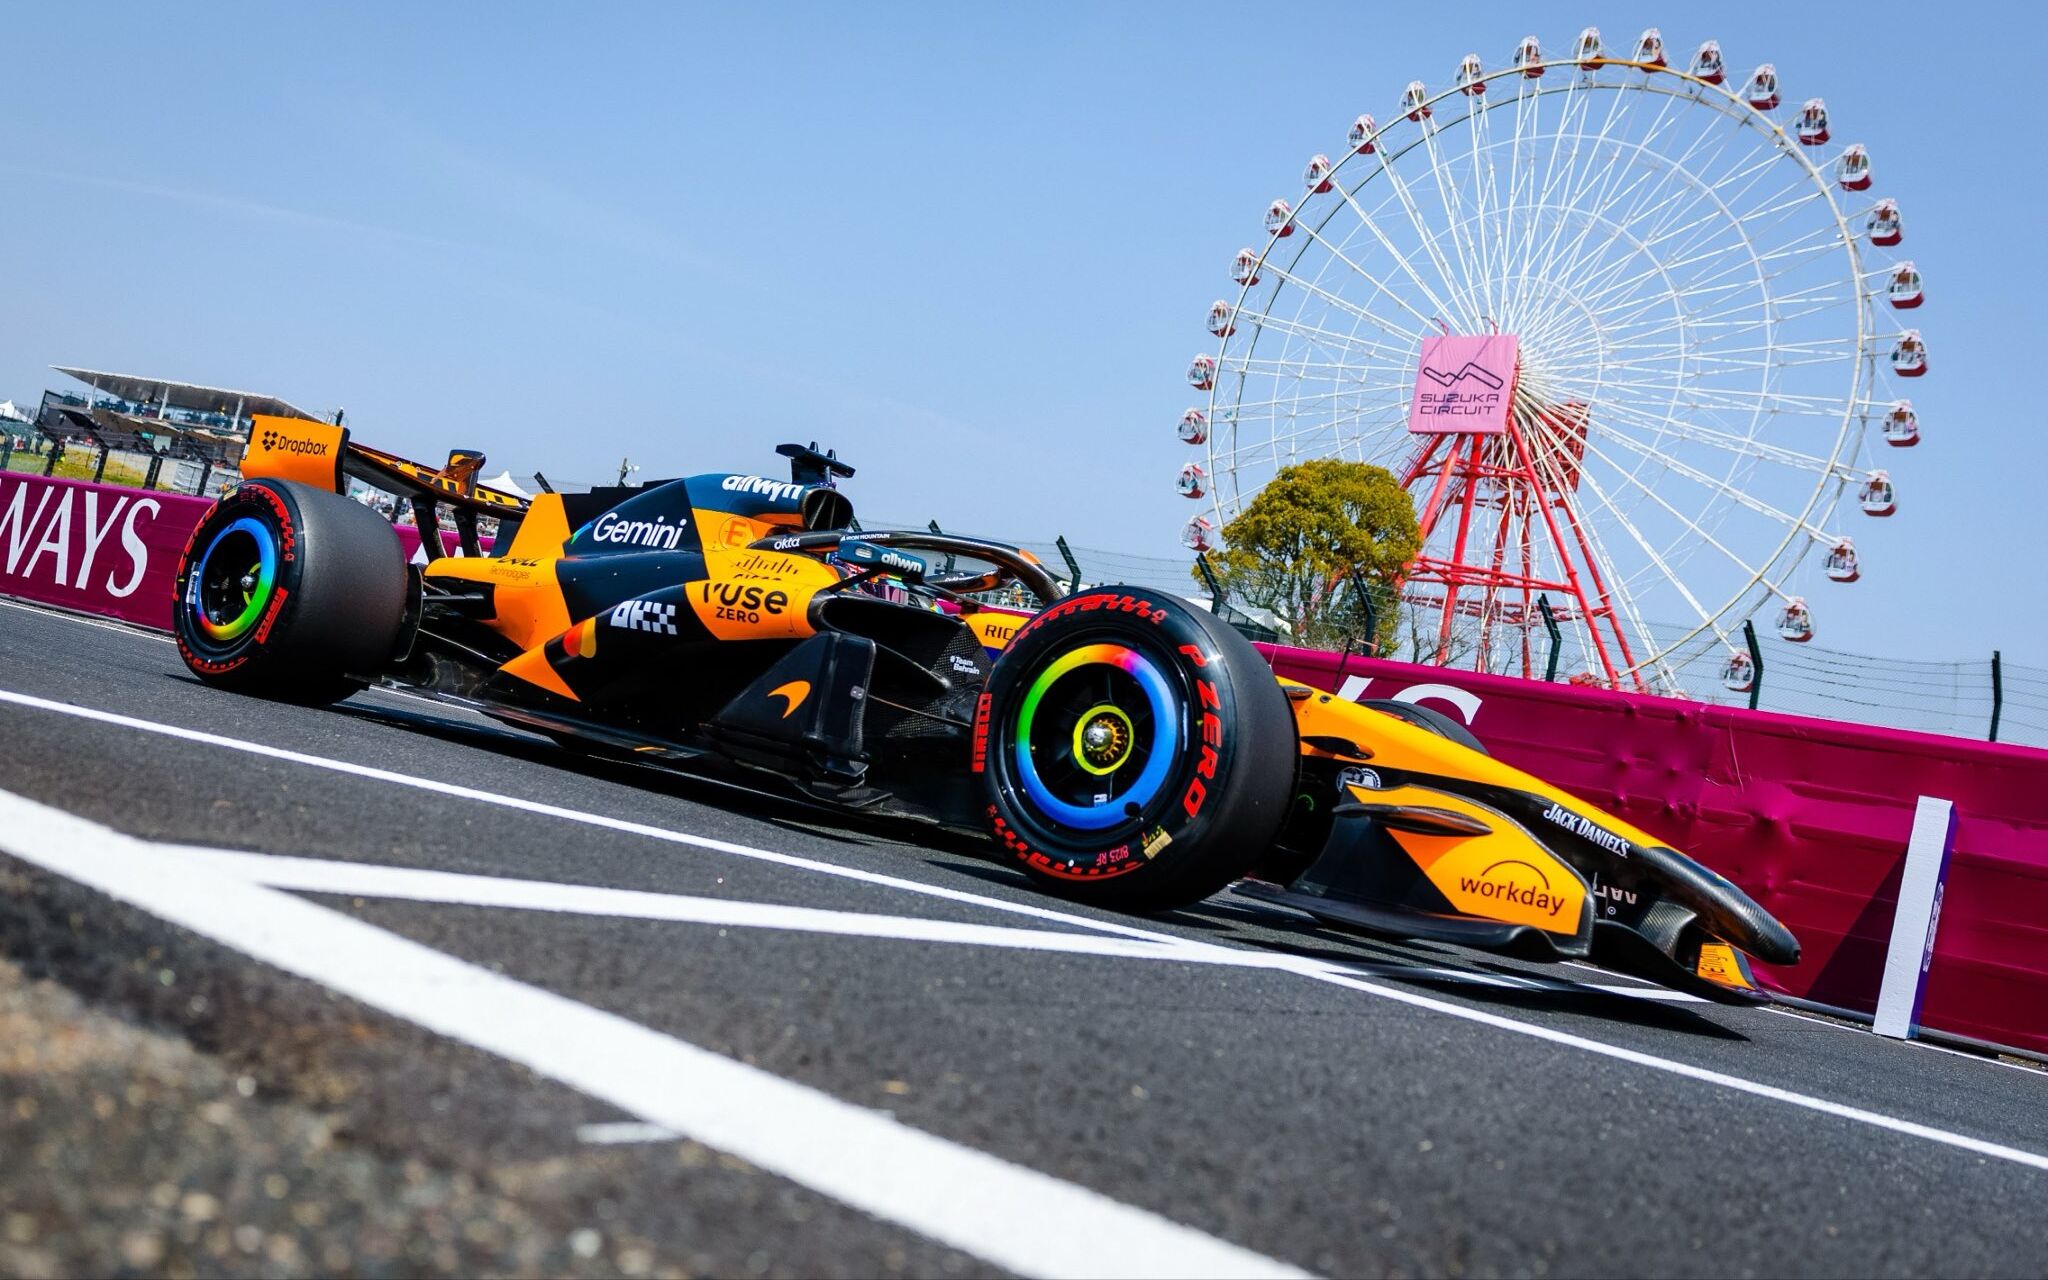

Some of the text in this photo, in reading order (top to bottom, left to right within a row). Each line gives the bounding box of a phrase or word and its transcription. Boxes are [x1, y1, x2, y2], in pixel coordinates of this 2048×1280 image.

[1420, 393, 1500, 403] SUZUKA
[1420, 405, 1496, 415] CIRCUIT
[278, 436, 327, 457] Dropbox
[722, 476, 805, 502] allwyn
[593, 512, 687, 549] Gemini
[774, 537, 800, 550] okta
[881, 552, 923, 573] allwyn
[716, 606, 760, 624] ZERO
[954, 663, 980, 675] Bahrain
[1178, 644, 1222, 818] P ZERO
[1543, 803, 1580, 832] JACK
[1460, 875, 1566, 917] workday
